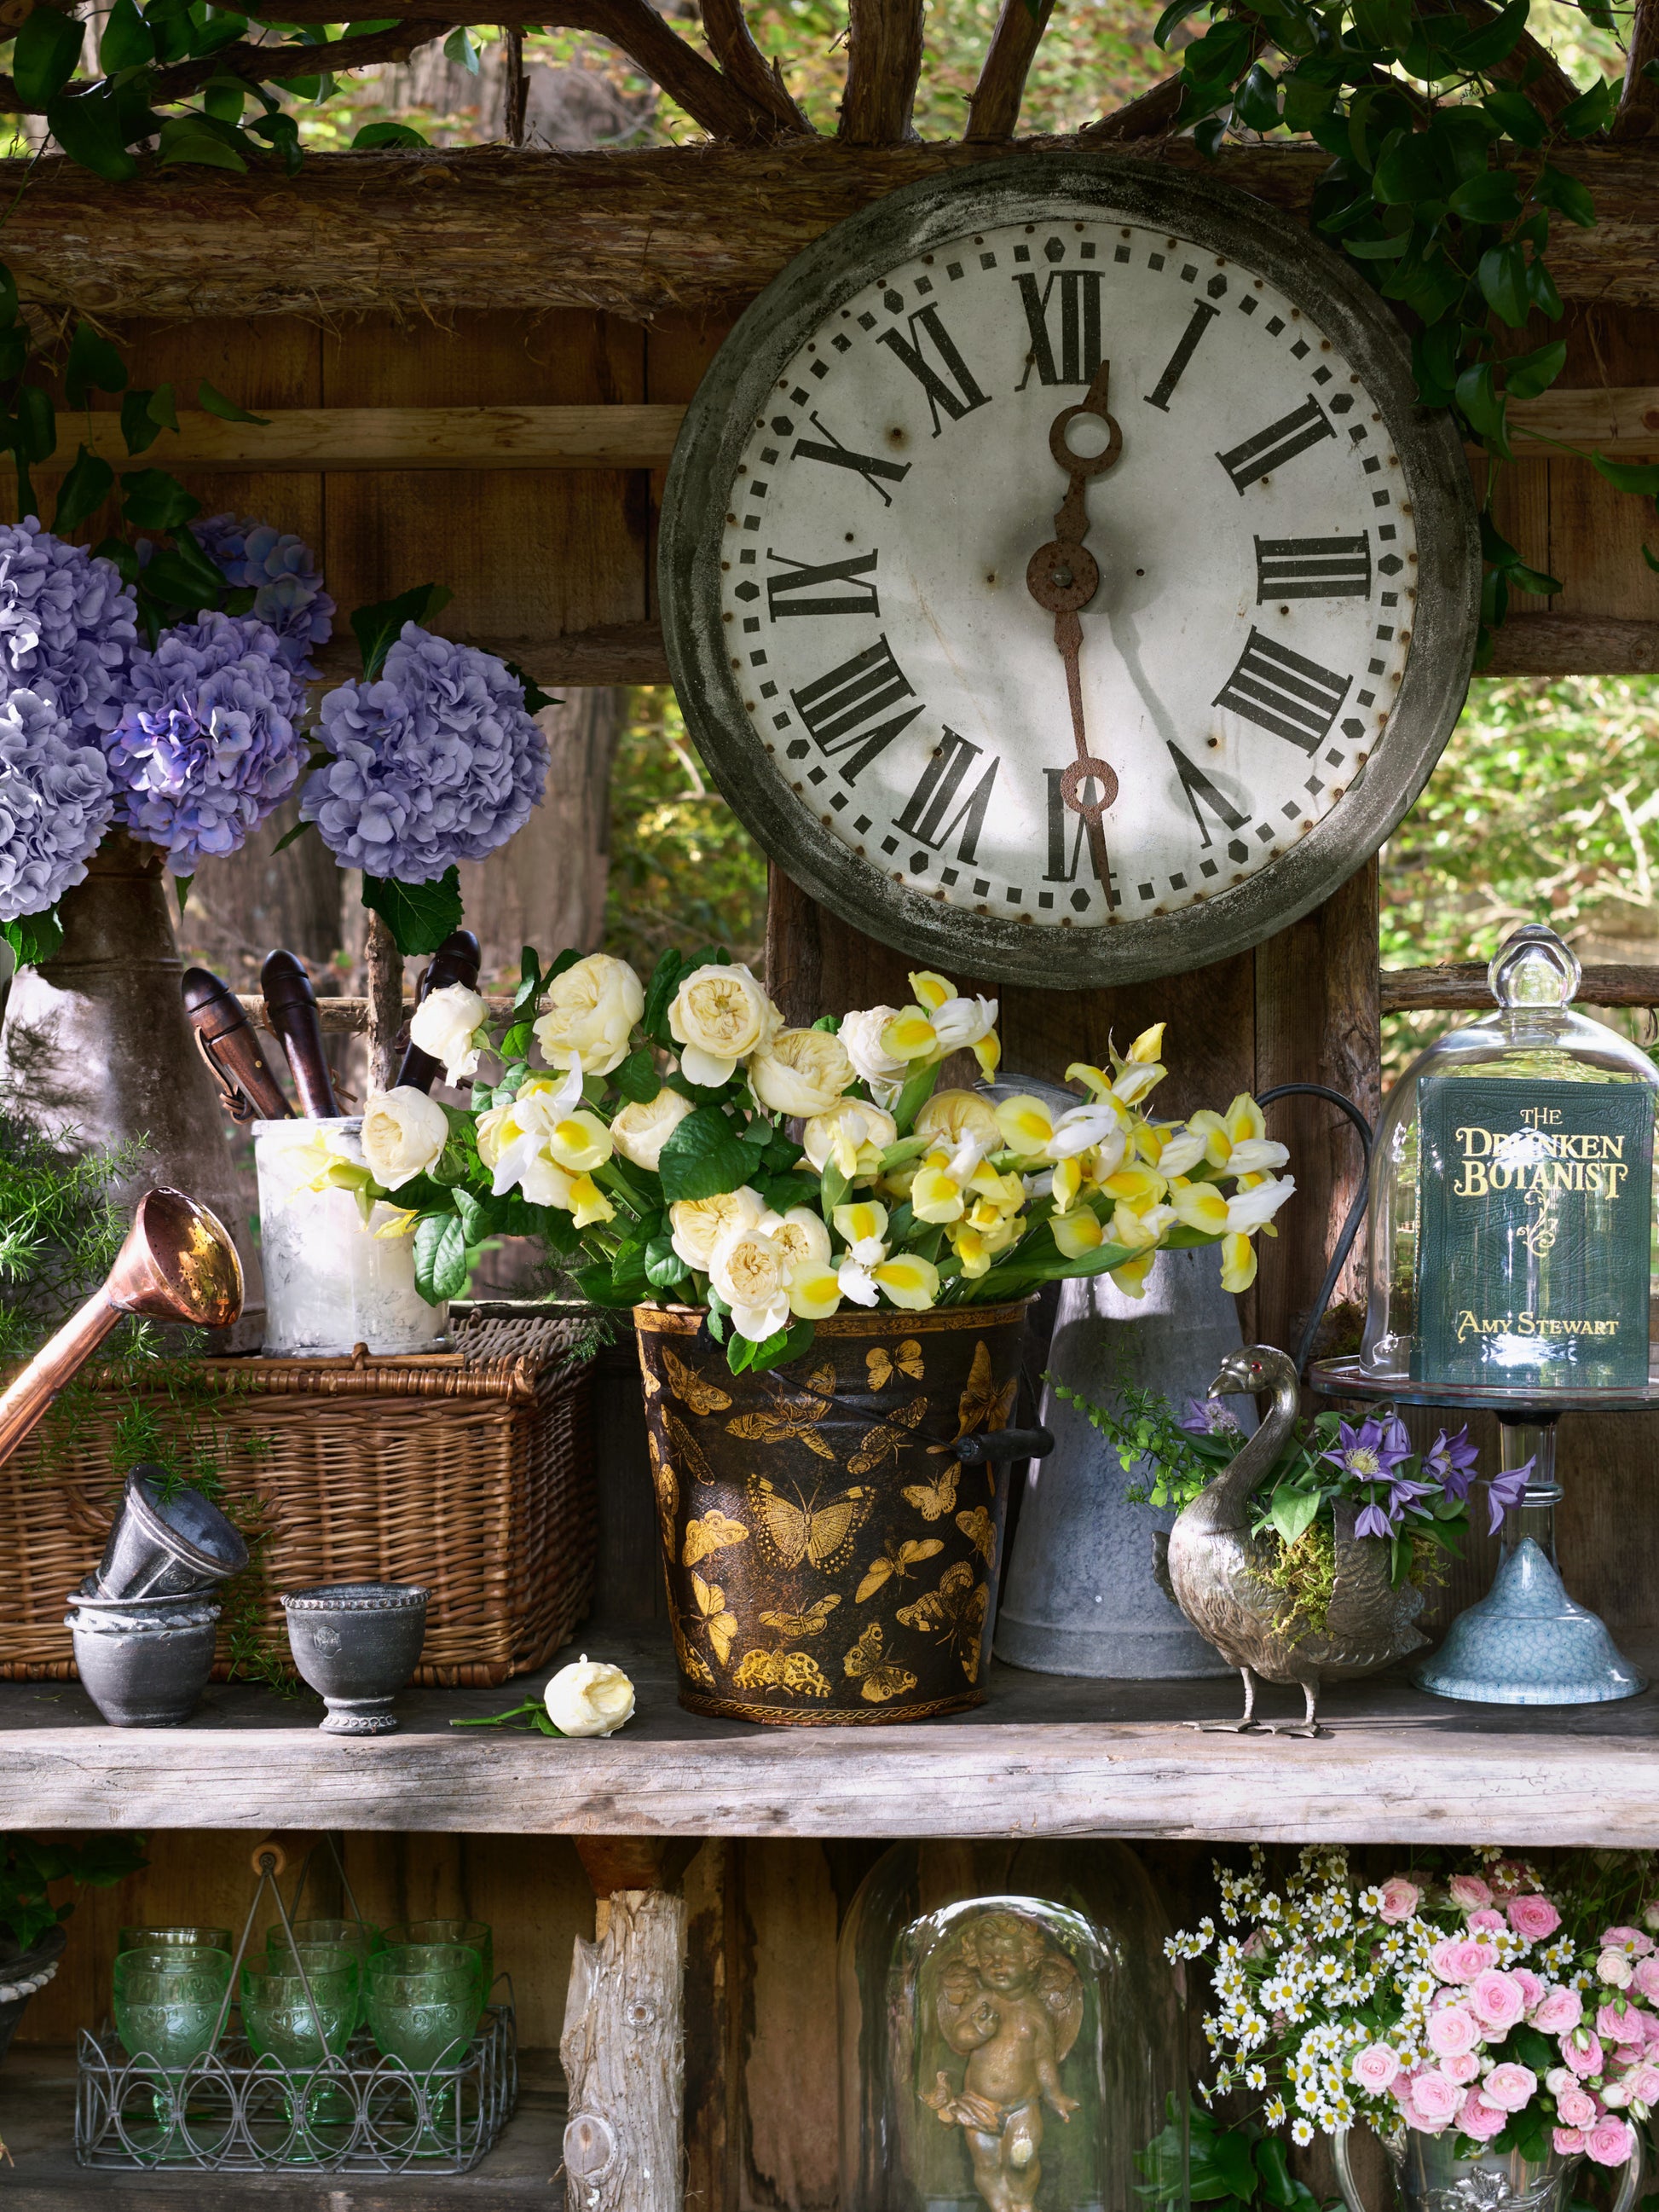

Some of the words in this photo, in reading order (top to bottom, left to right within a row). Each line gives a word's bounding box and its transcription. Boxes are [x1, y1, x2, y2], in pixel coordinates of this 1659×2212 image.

[876, 301, 992, 439] XI
[1011, 269, 1106, 392] XII
[1143, 298, 1221, 413] I
[790, 411, 912, 507] X
[1214, 393, 1338, 497] II
[766, 547, 880, 623] IX
[1253, 530, 1371, 605] III
[789, 632, 926, 788] VIII
[1211, 624, 1354, 759] IIII
[892, 724, 1001, 866] VII
[1166, 738, 1251, 849] V
[1455, 1127, 1625, 1159] DRNKEN
[1520, 1107, 1564, 1131] THE
[1454, 1161, 1628, 1200] BOTANIST
[1457, 1310, 1512, 1344] AMY
[1517, 1312, 1620, 1335] STEWART
